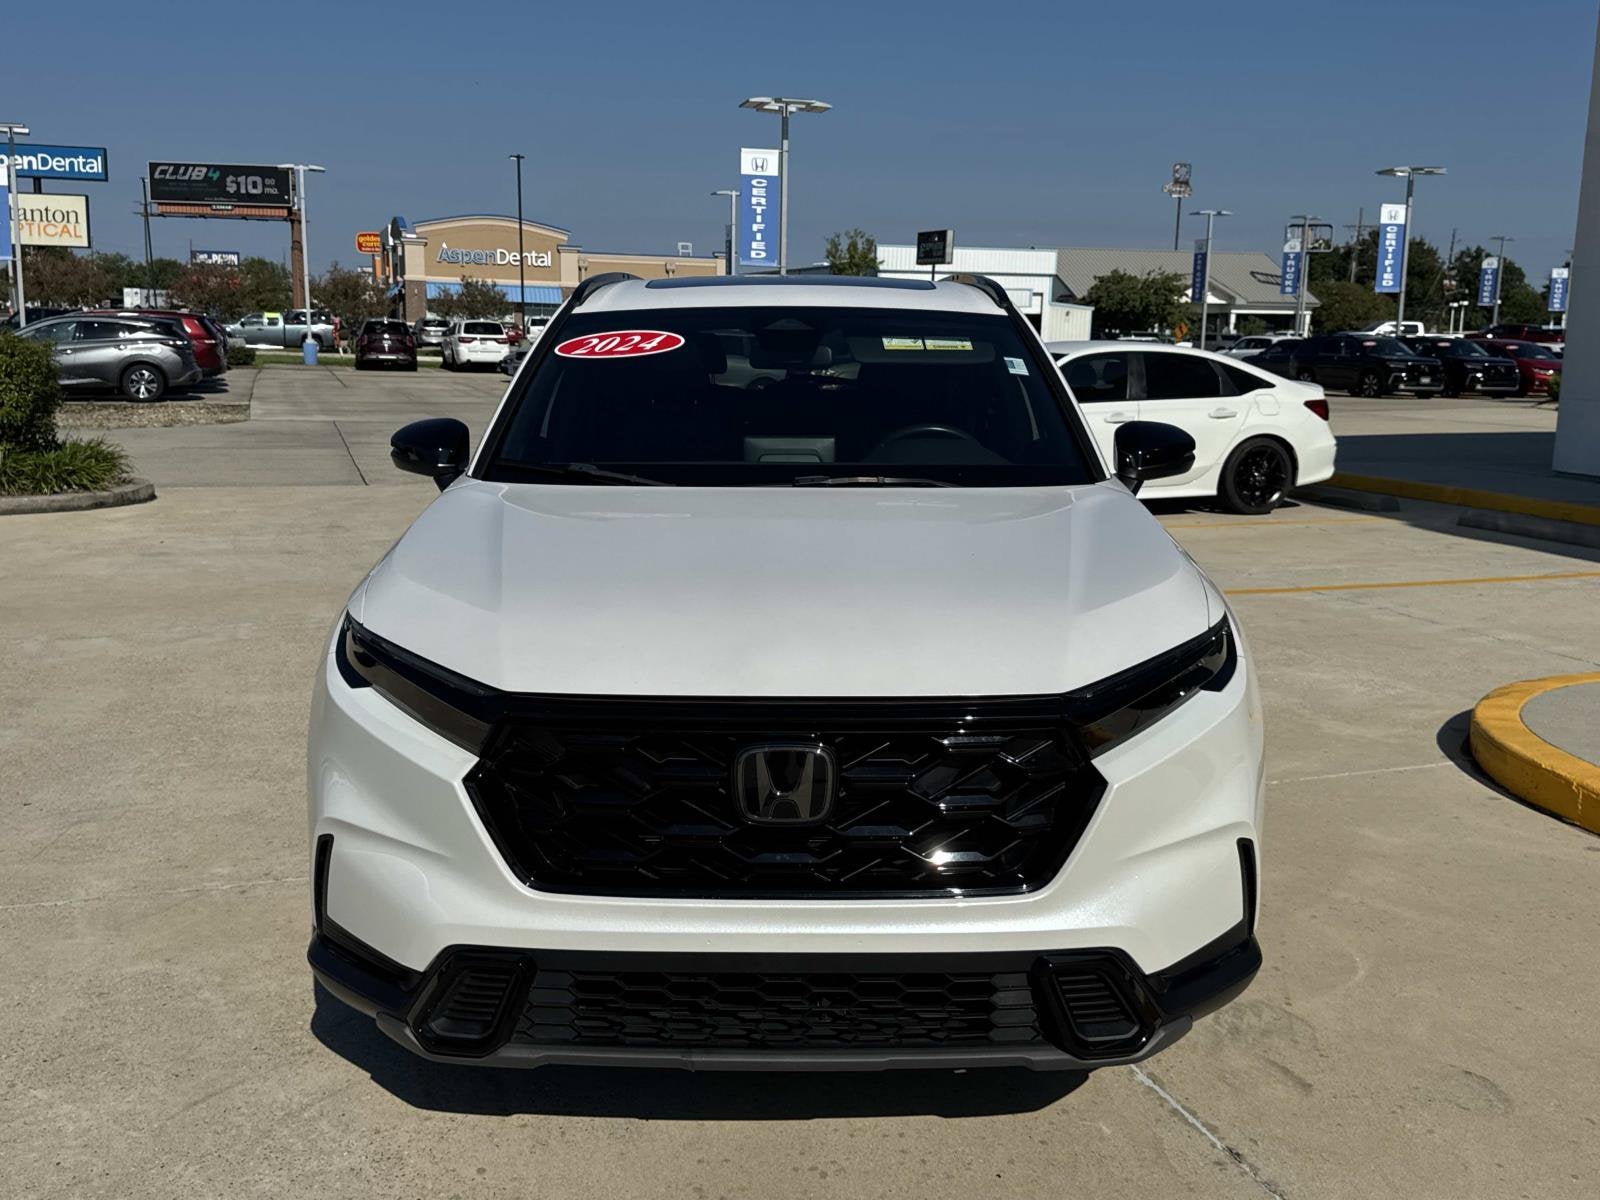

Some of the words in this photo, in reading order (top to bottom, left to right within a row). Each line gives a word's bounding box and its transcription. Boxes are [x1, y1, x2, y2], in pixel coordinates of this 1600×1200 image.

[226, 175, 263, 194] $10
[750, 178, 768, 259] CERTIFIED
[1284, 253, 1296, 293] TRUCKS
[1381, 225, 1398, 287] CERTIFIED
[570, 334, 668, 354] 2024
